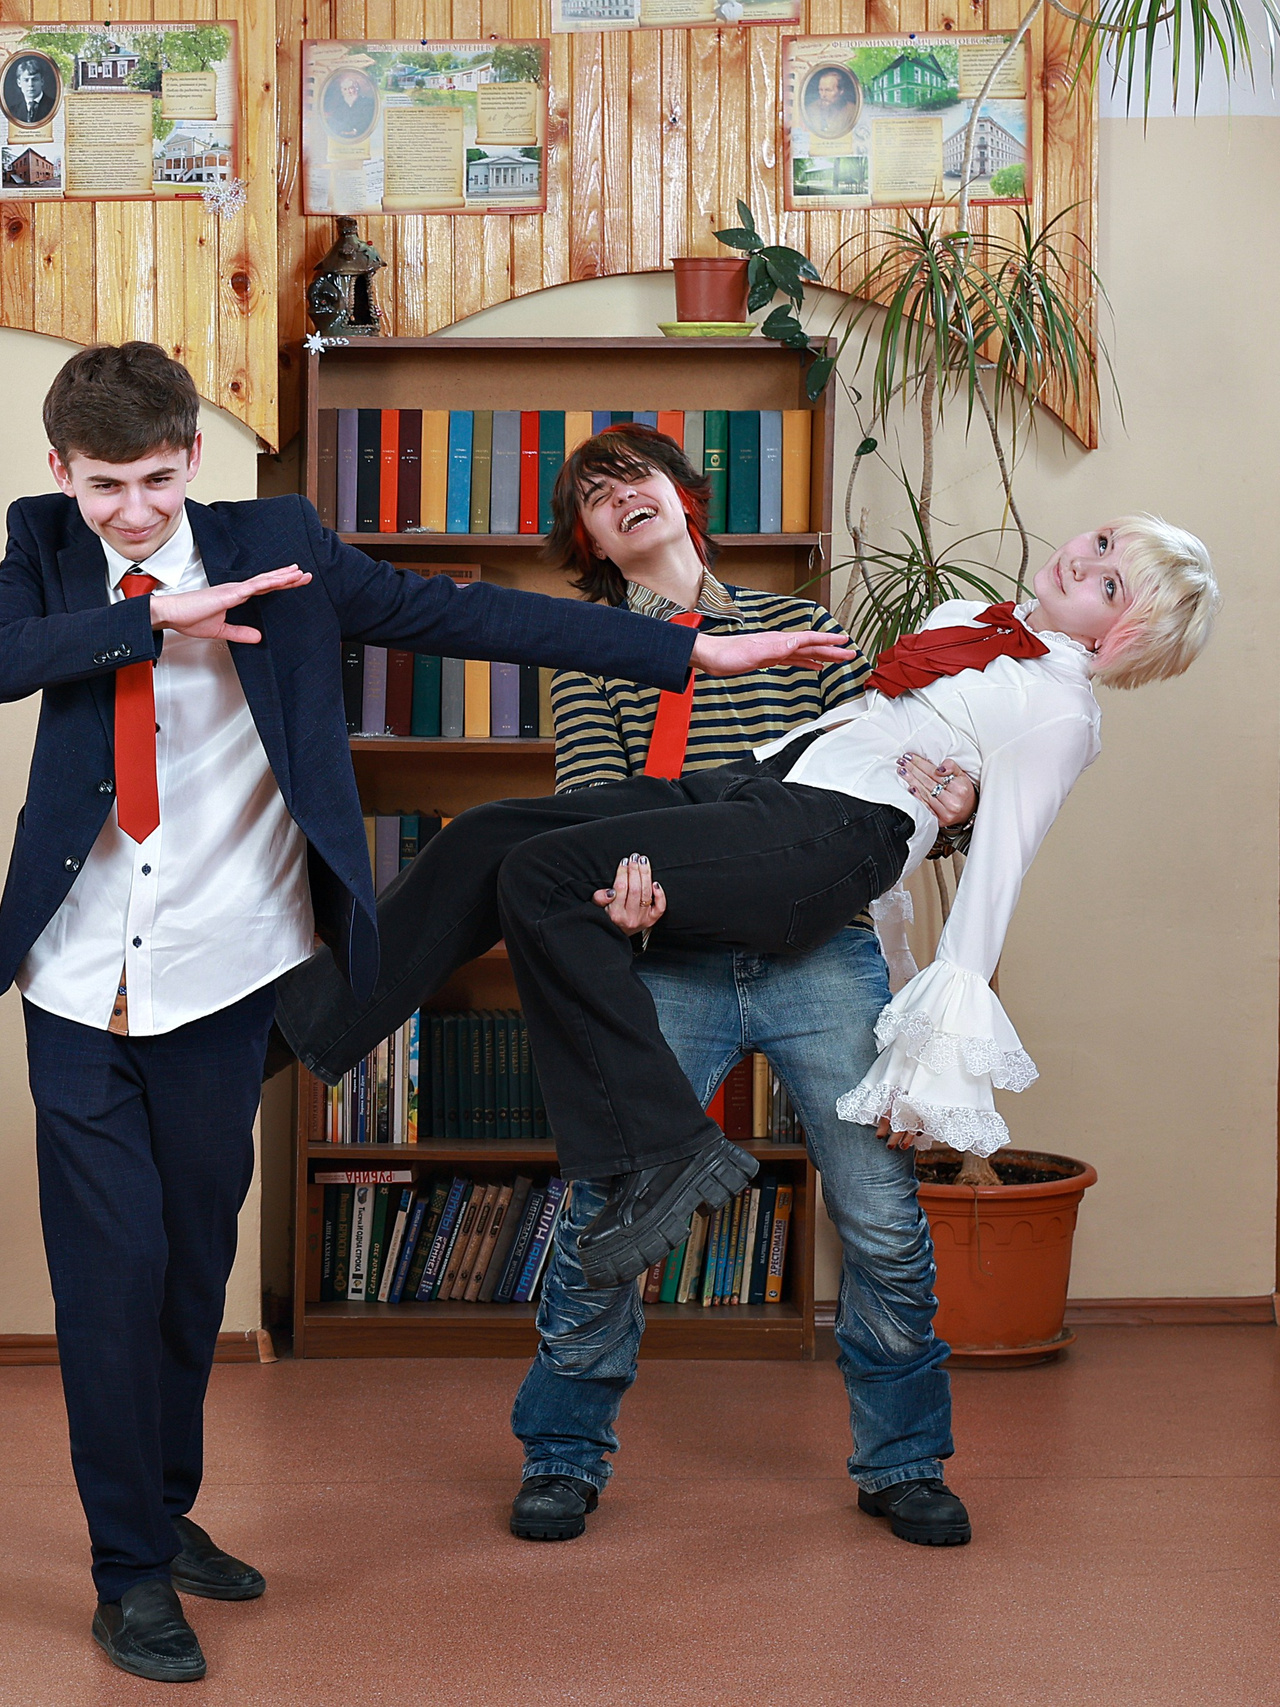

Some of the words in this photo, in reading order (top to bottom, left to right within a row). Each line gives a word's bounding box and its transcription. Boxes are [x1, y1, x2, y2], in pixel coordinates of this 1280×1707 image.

[511, 1029, 519, 1074] СТЕНДАЛЬ
[345, 1171, 393, 1183] РУБИНА
[441, 1181, 465, 1232] ТАЙНЫ
[515, 1196, 540, 1257] ВОСКРЕСЕНИЕ
[763, 1211, 771, 1239] ЦВЕТАЕВА
[336, 1223, 348, 1257] БРЮСОВ
[355, 1231, 363, 1248] ОДНА
[426, 1235, 443, 1275] КАМНЕЙ
[515, 1241, 542, 1296] ТАЙНЫ
[534, 1202, 556, 1241] НЛО
[770, 1219, 783, 1275] ХРЕСТОМАТИЯ
[323, 1241, 331, 1279] АХМАТОВА
[354, 1249, 362, 1272] СТРОКА
[367, 1258, 379, 1294] Сельское
[373, 1243, 381, 1257] эхо
